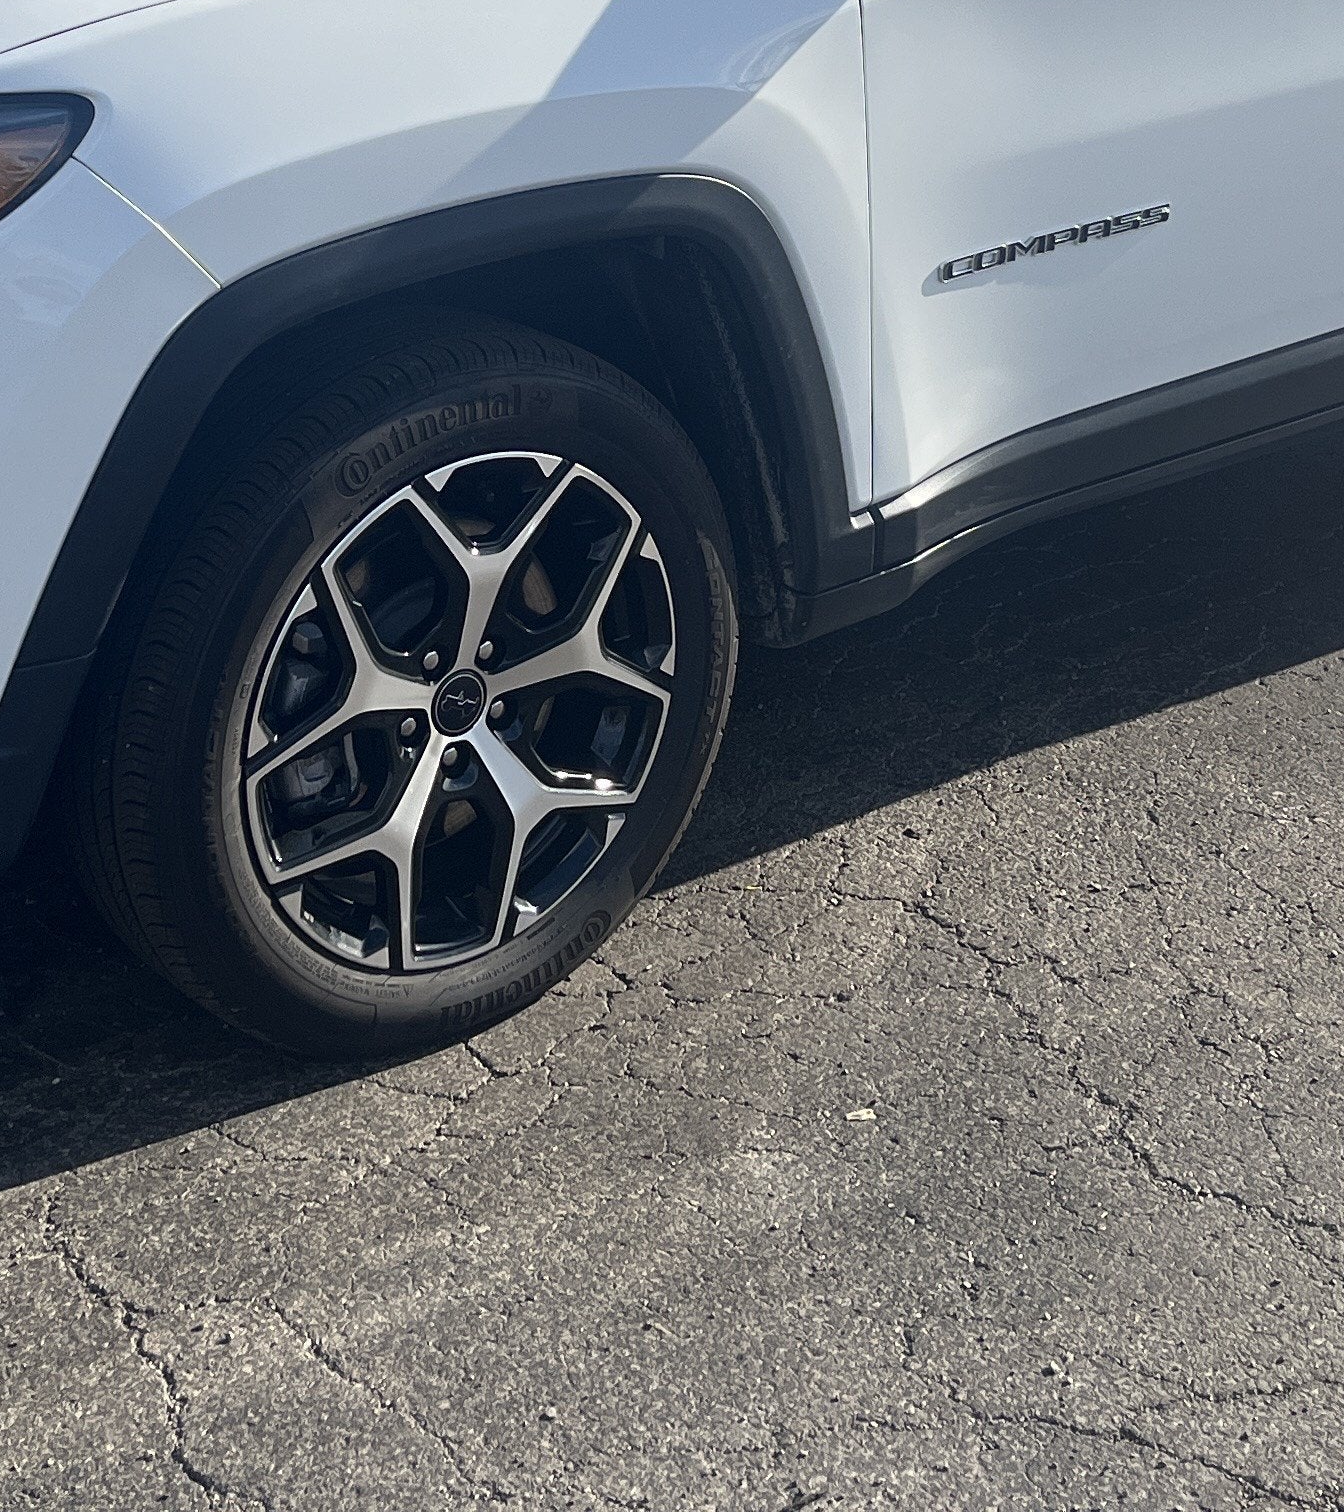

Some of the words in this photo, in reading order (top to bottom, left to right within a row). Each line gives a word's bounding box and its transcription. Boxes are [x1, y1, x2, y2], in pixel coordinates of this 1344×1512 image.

[940, 202, 1171, 283] COMPASS
[335, 384, 522, 498] Continental
[440, 909, 612, 1027] Continental
